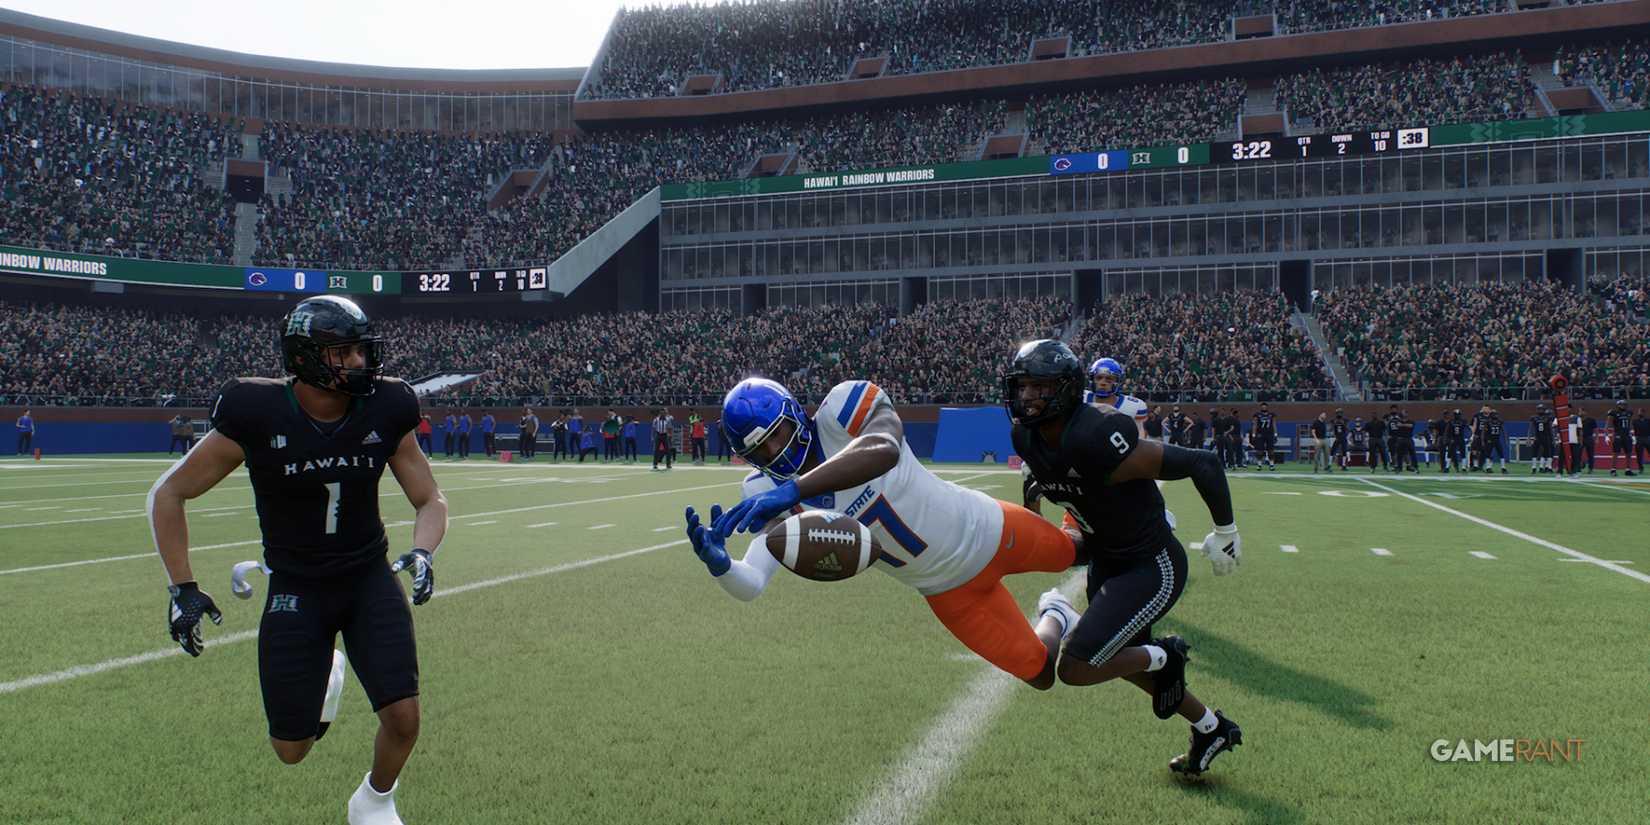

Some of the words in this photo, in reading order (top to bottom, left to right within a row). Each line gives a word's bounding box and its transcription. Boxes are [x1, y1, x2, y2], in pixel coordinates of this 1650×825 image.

[1331, 134, 1353, 143] DOWN
[1374, 140, 1386, 152] 10
[1402, 132, 1423, 145] :38
[1178, 147, 1189, 164] 0
[1232, 140, 1272, 160] 3:22
[1301, 146, 1307, 157] 1
[1338, 143, 1345, 154] 2
[1097, 153, 1108, 170] 0
[842, 173, 884, 186] RAINBOW
[886, 169, 935, 183] WARRIORS
[42, 256, 107, 276] WARRIORS
[294, 271, 305, 290] 0
[372, 274, 383, 292] 0
[419, 273, 450, 292] 3:22
[1109, 431, 1130, 455] 9
[283, 454, 375, 476] HAWAI'I
[323, 482, 342, 534] 1
[844, 485, 875, 517] STATE
